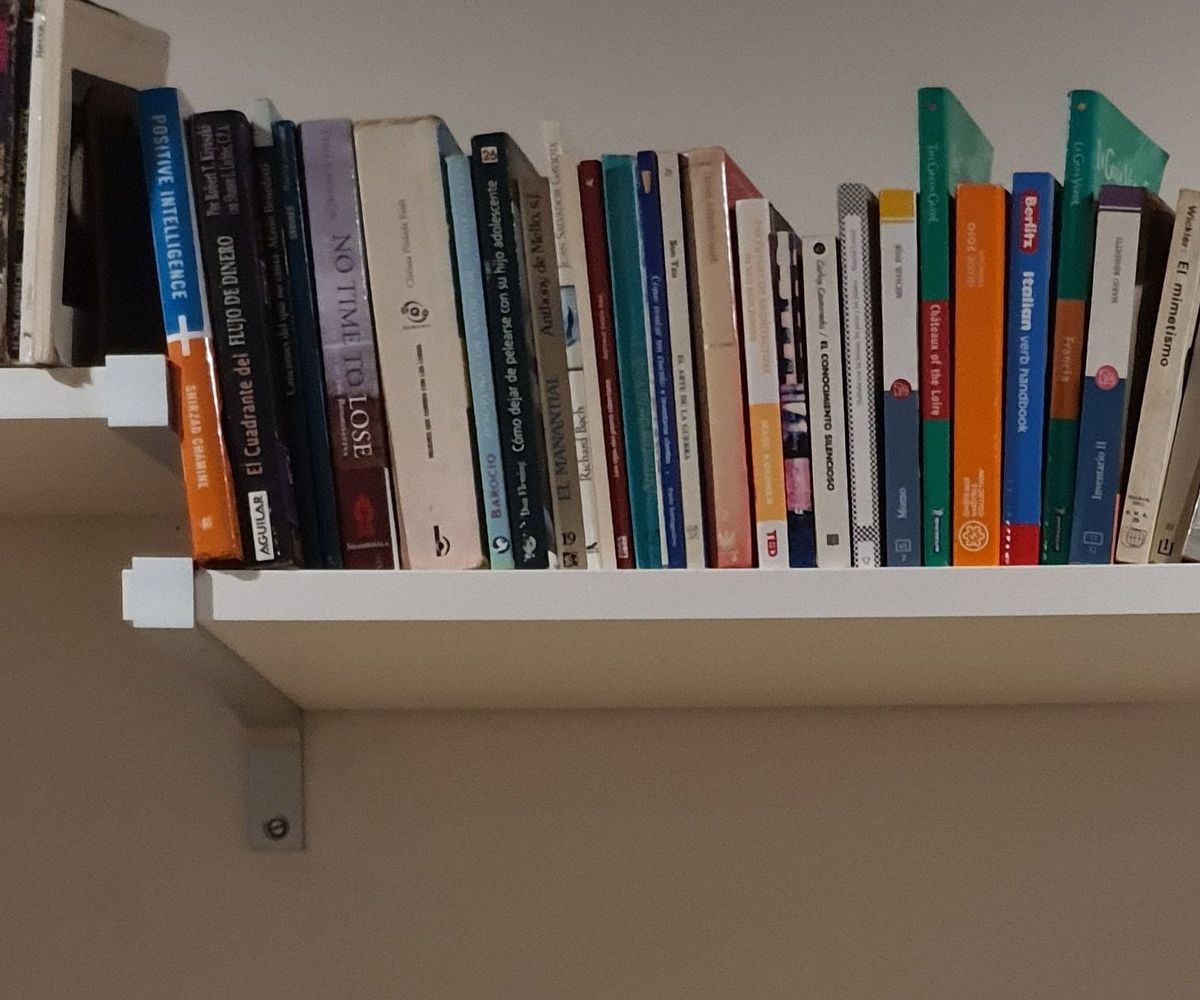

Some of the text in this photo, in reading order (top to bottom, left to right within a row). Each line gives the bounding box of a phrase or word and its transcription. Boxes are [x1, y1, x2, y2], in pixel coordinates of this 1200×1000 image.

[195, 123, 215, 162] Kiyosaki
[150, 113, 189, 300] POSITIVE INTELLIGENCE
[201, 171, 219, 201] Robert
[331, 233, 354, 273] NO
[1022, 195, 1038, 249] Berlitz
[533, 256, 548, 273] de
[667, 238, 681, 279] Sun Tzu
[812, 258, 828, 285] Carlos
[1174, 259, 1190, 275] El
[335, 277, 362, 344] TIME
[482, 178, 526, 452] Cómo dejar de pelearse con su hijo adolescente
[535, 277, 557, 337] Anthony
[1157, 282, 1186, 368] mimetismo
[215, 234, 263, 475] El Cuadrante del FLUJO DE DINERO
[342, 347, 366, 388] TO
[929, 303, 941, 416] Châteaux of the Loire
[1016, 270, 1035, 433] Italian verb handbook
[1059, 335, 1075, 383] Francia
[183, 382, 211, 490] SHIRZAD CHAMINE
[347, 395, 373, 458] LOSE
[676, 353, 692, 461] EL ARTE DE LA GUERRA
[818, 339, 837, 491] EL CONOCIMIENTO SILENCIOSO
[540, 378, 573, 500] EL MANANTIAL
[569, 405, 596, 482] Richard Bach
[1089, 439, 1107, 500] Inventario II
[483, 452, 504, 519] BAROCIO
[251, 494, 271, 556] AGUILAR
[560, 531, 575, 544] 19
[764, 529, 780, 558] TED
